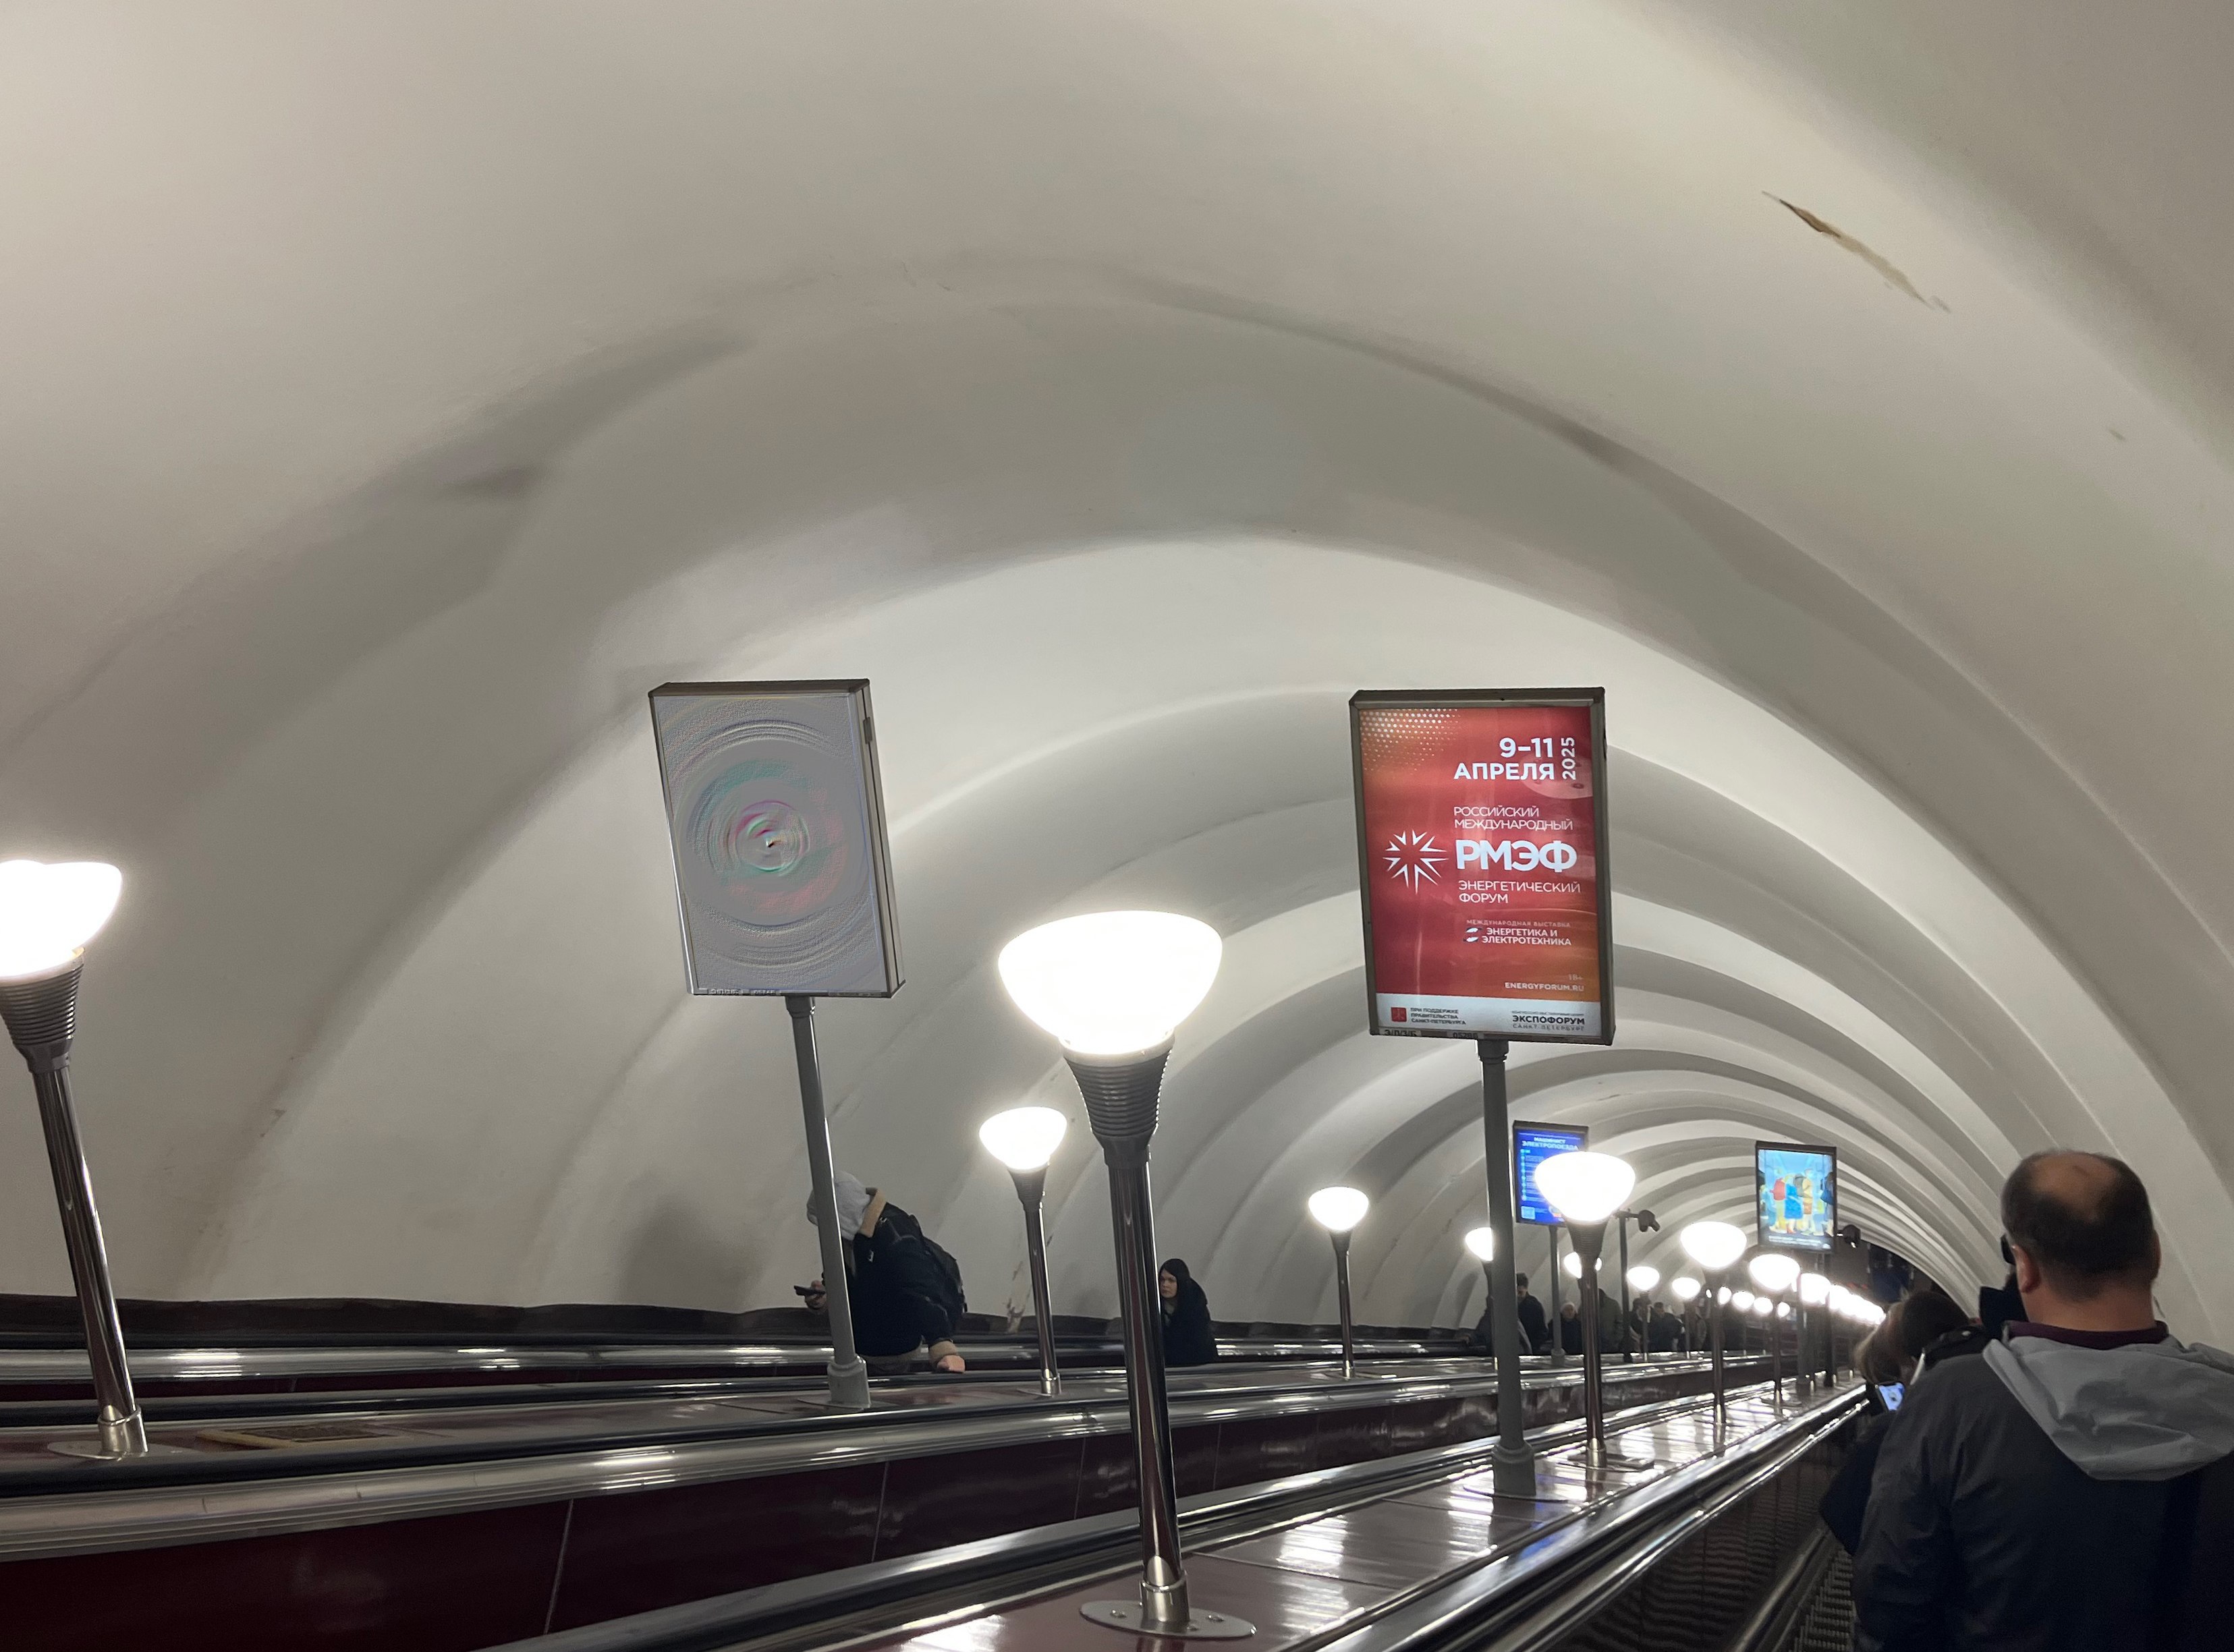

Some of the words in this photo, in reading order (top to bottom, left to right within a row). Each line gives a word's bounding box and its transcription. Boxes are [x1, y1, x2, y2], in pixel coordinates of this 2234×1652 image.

[1561, 737, 1576, 780] 2025
[1453, 762, 1555, 780] АПРЕЛЯ
[1453, 805, 1540, 818] РОССИЙСКИЙ
[1455, 818, 1573, 831] МЕЖДУНАРОДНЫЙ
[1455, 839, 1577, 873] РМЭФ
[1458, 880, 1581, 893] ЭНЕРГЕТИЧЕСКИЙ
[1459, 892, 1509, 904] ФОРУМ
[1486, 927, 1548, 936] ЭНЕРГЕТИКА
[1482, 936, 1572, 946] ЭЛЕКТРОТЕХНИКА
[1505, 982, 1585, 992] ENERGYFORUM.RU
[1512, 1015, 1585, 1025] ЭКСПОФОРУМ
